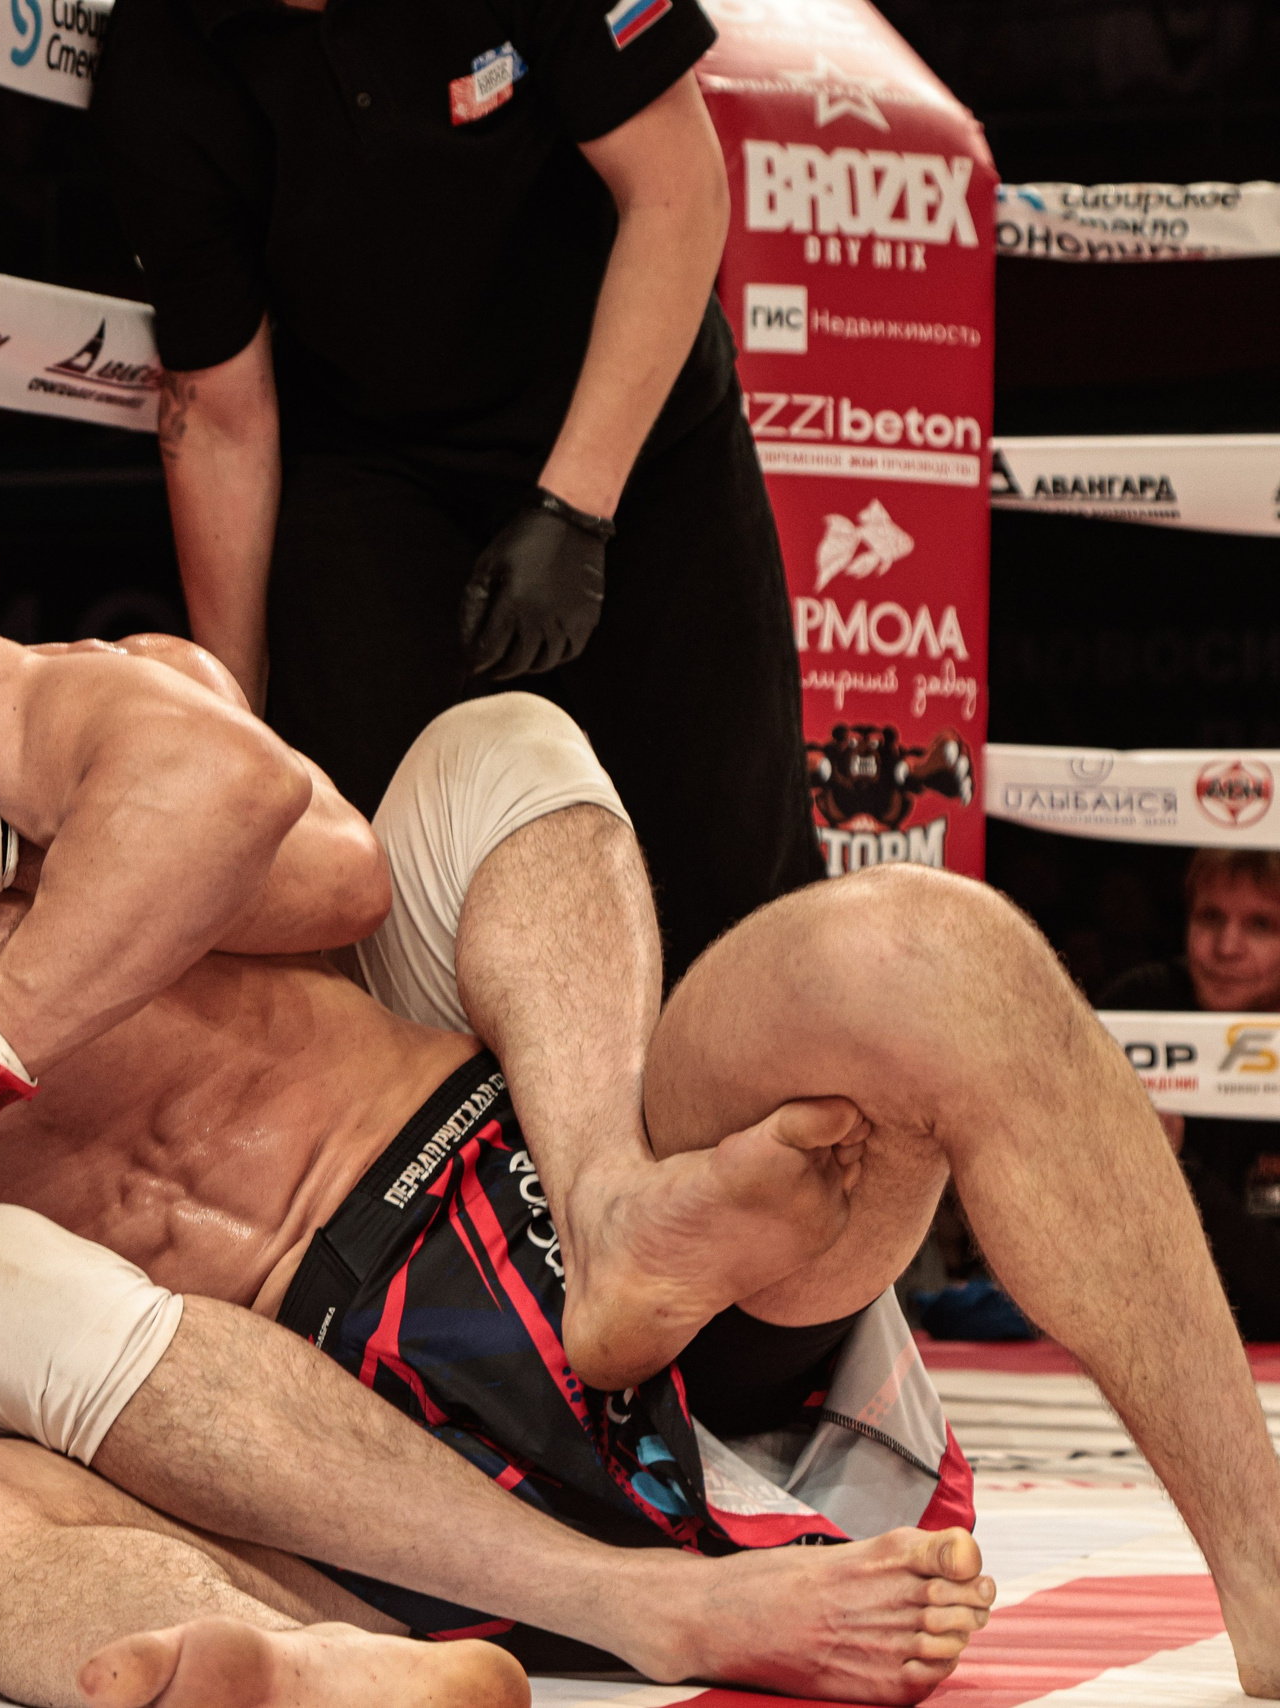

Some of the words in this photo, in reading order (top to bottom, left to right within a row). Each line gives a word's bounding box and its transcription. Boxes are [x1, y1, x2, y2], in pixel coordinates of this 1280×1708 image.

[743, 139, 979, 247] BROZEX
[805, 236, 860, 266] DRY
[873, 239, 926, 271] MIX
[750, 305, 804, 331] ГИС
[810, 309, 981, 348] Недвижимость
[838, 397, 981, 449] beton
[1034, 474, 1178, 505] АВАНГАРД
[794, 597, 969, 661] РМОЛА
[802, 664, 899, 712] лирный
